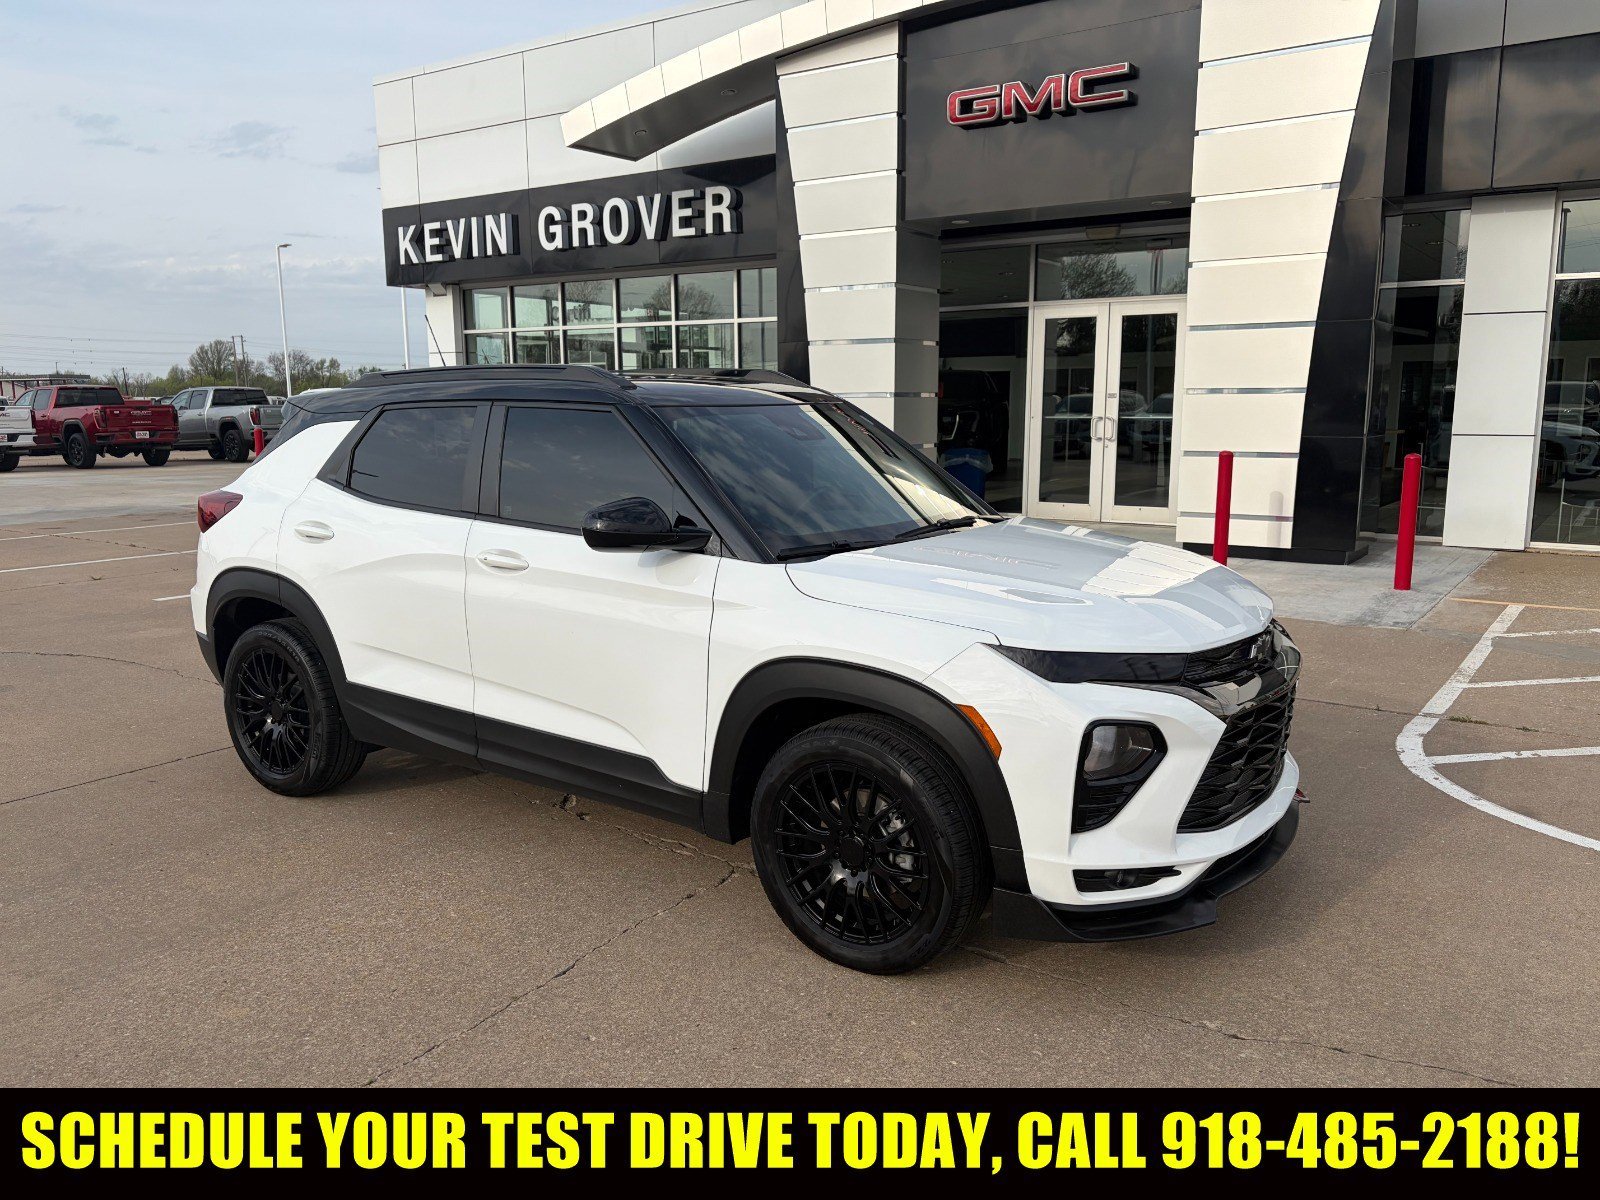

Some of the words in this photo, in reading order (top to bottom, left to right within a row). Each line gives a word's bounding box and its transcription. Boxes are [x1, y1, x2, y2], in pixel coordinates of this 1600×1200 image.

[946, 61, 1132, 126] GMC
[397, 211, 510, 266] KEVIN
[537, 185, 737, 252] GROVER
